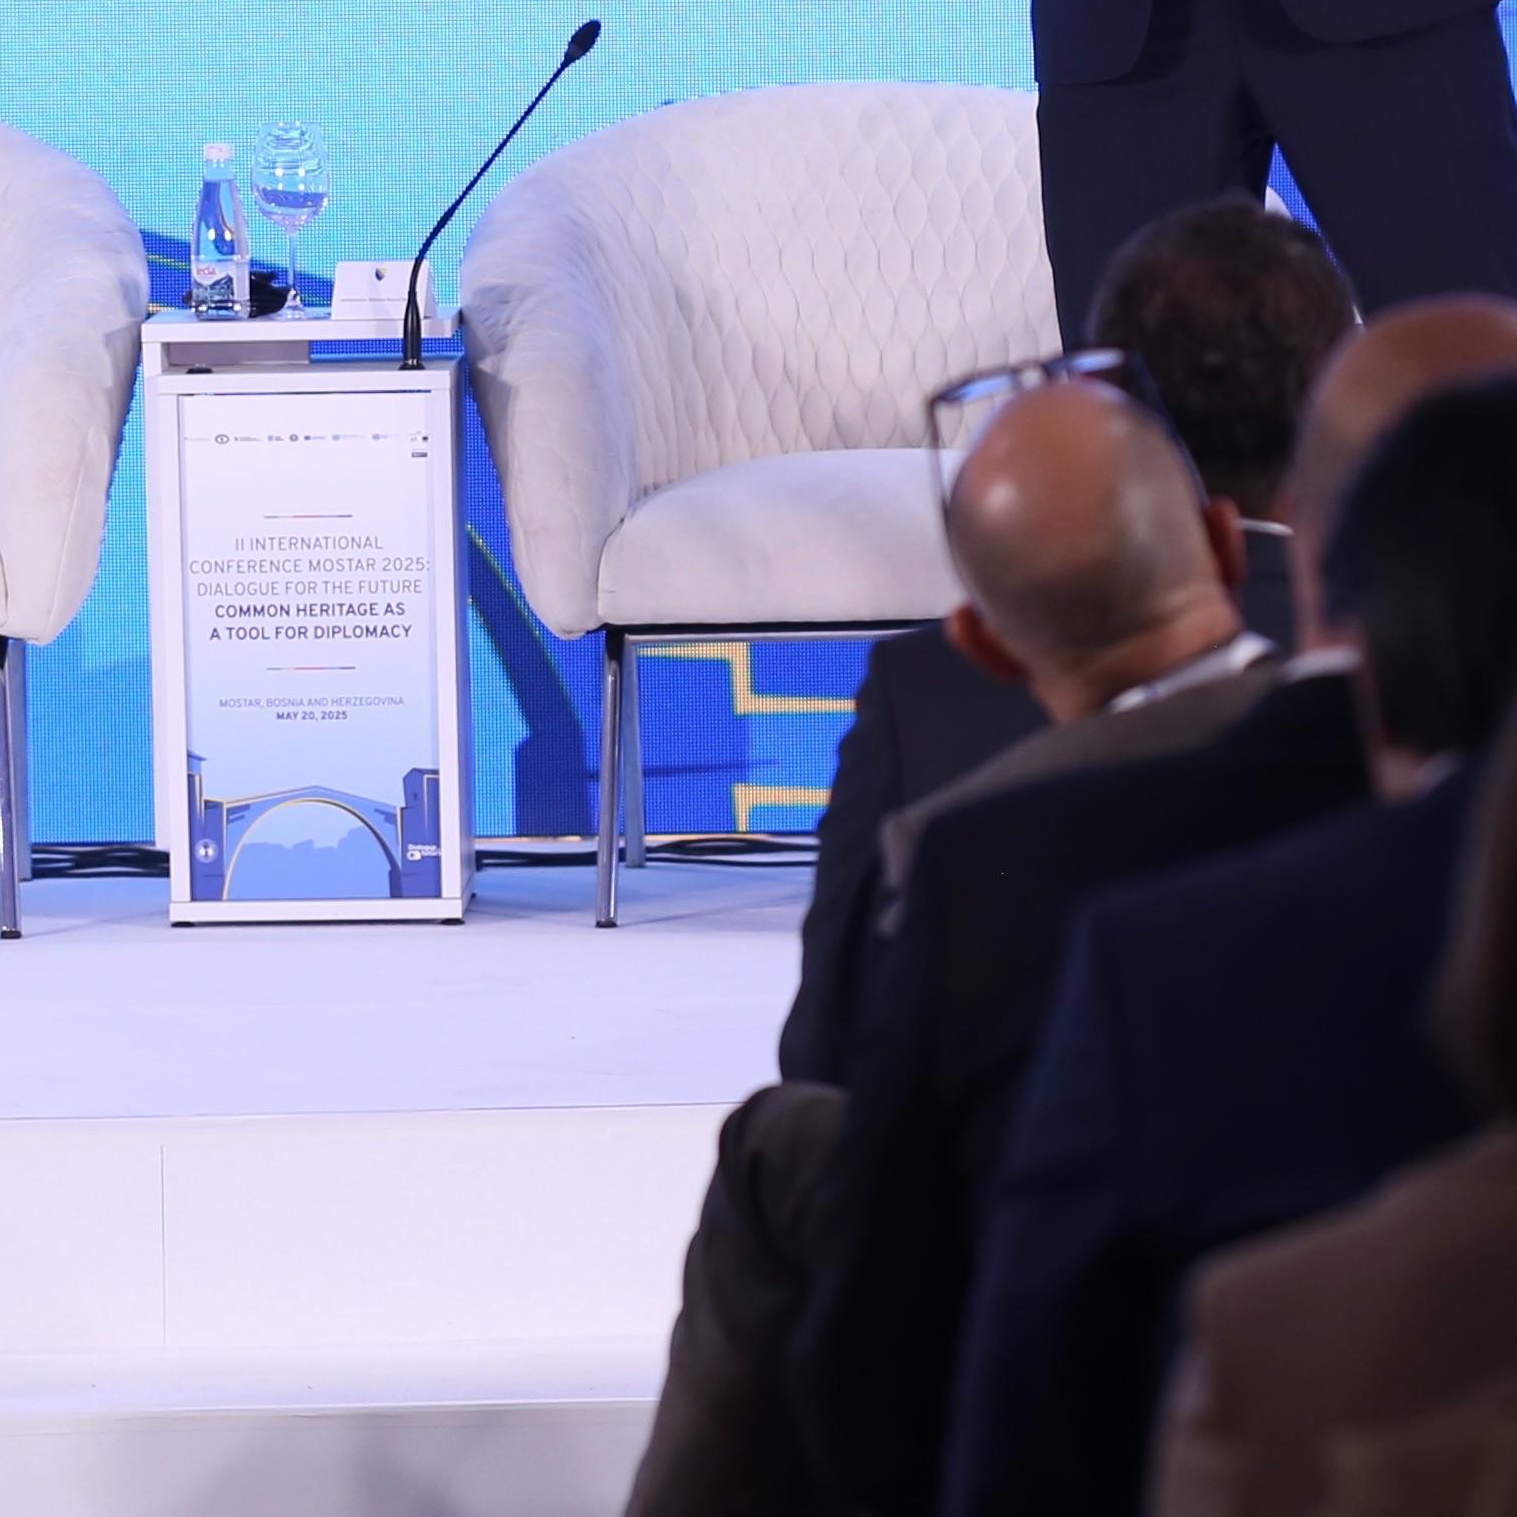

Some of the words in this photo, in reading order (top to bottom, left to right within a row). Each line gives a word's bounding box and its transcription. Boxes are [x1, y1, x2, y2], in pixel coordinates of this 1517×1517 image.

[235, 537, 245, 552] II
[250, 535, 384, 552] INTERNATIONAL
[188, 558, 303, 575] CONFERENCE
[308, 557, 377, 573] MOSTAR
[381, 556, 431, 572] 2025:
[196, 580, 280, 597] DIALOGUE
[284, 580, 318, 596] FOR
[321, 579, 354, 595] THE
[358, 578, 423, 595] FUTURE
[214, 603, 291, 619] COMMON
[296, 602, 379, 618] HERITAGE
[383, 601, 406, 616] AS
[208, 626, 222, 642] A
[225, 626, 271, 641] TOOL
[274, 625, 309, 640] FOR
[313, 624, 412, 640] DIPLOMACY
[218, 697, 263, 710] MOSTAR,
[265, 697, 306, 708] BOSNIA
[306, 697, 329, 707] AND
[330, 696, 405, 707] HERZEGOVINA
[275, 710, 299, 721] MAY
[320, 710, 348, 721] 2025
